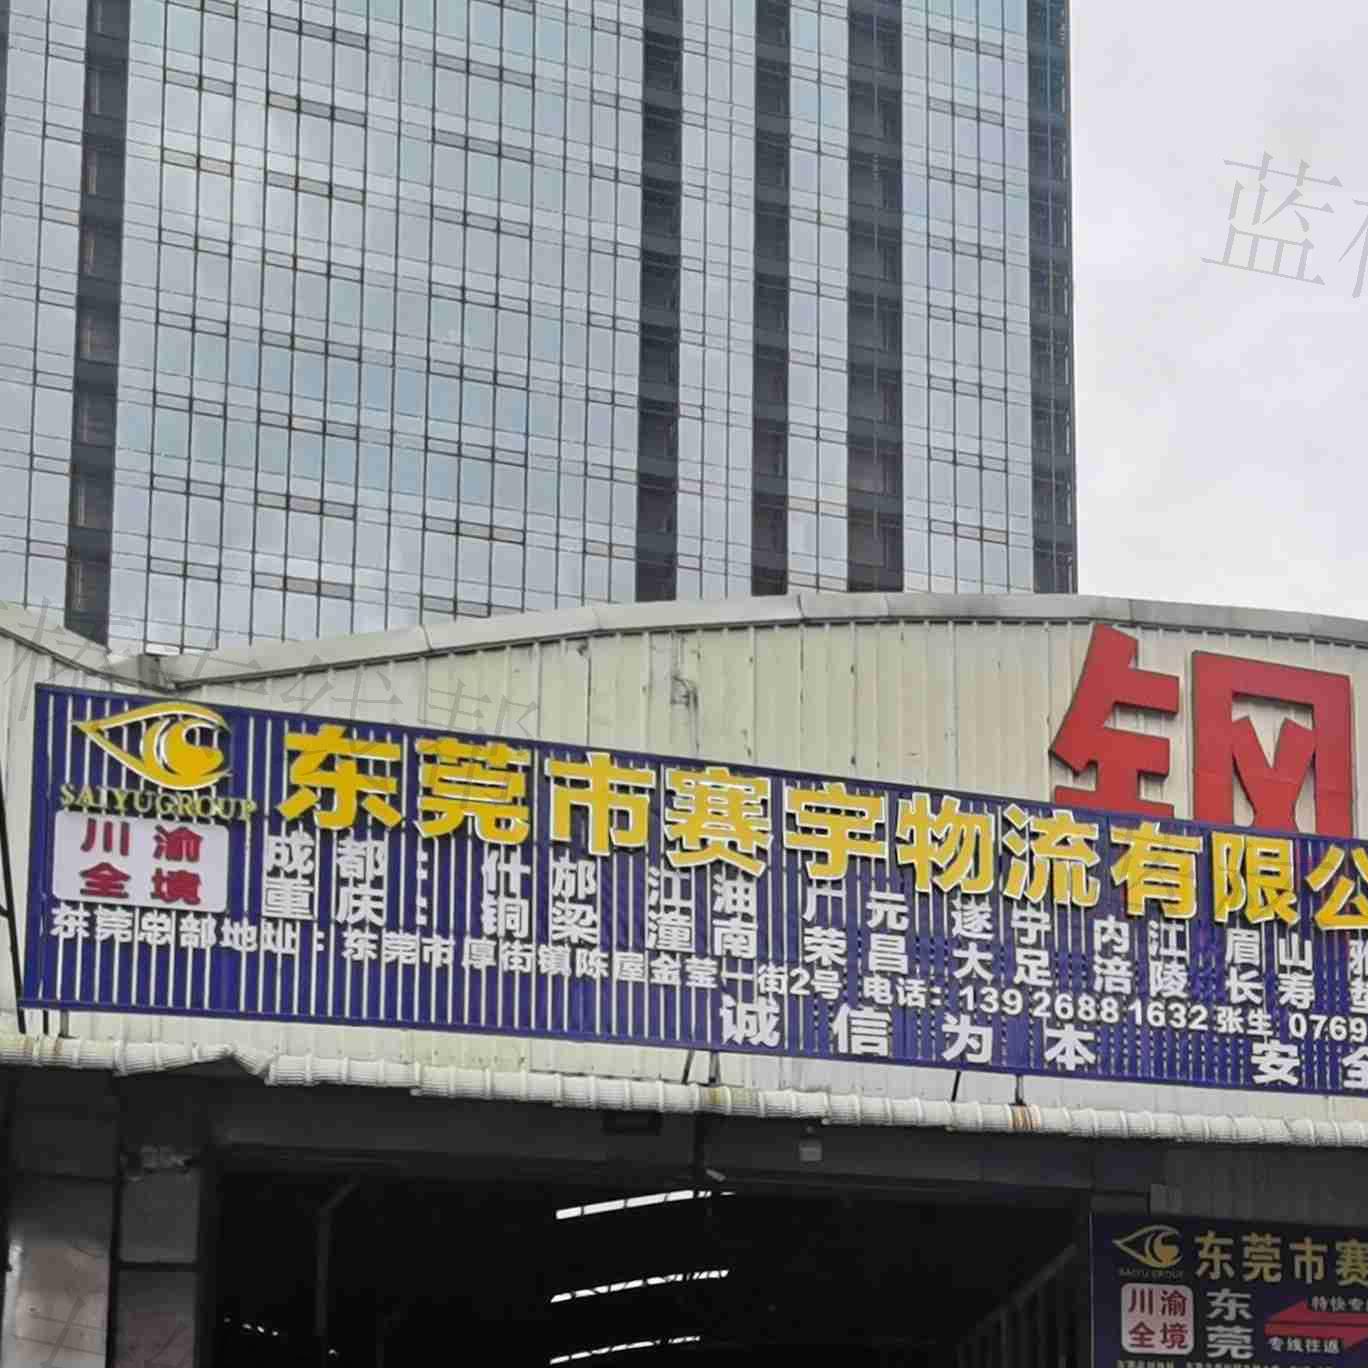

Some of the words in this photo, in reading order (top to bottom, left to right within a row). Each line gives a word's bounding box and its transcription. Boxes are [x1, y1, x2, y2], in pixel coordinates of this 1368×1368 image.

[80, 817, 203, 863] 川渝
[79, 861, 201, 905] 全境
[647, 867, 757, 916] 江油
[951, 900, 1051, 944] 遂宁
[1093, 916, 1189, 960] 内江
[1226, 928, 1312, 969] 眉山
[481, 896, 600, 944] 铜梁
[804, 928, 908, 974] 荣昌
[952, 943, 1052, 988] 大足
[1226, 968, 1315, 1009] 长寿
[720, 994, 1097, 1072] 诚信为本
[959, 985, 1023, 1014] 139
[1032, 992, 1119, 1023] 2688
[1129, 999, 1208, 1031] 1632
[1216, 1006, 1273, 1036] 张生
[1128, 1289, 1187, 1317] 川渝
[1206, 1287, 1254, 1360] 东莞
[1128, 1321, 1188, 1350] 全境
